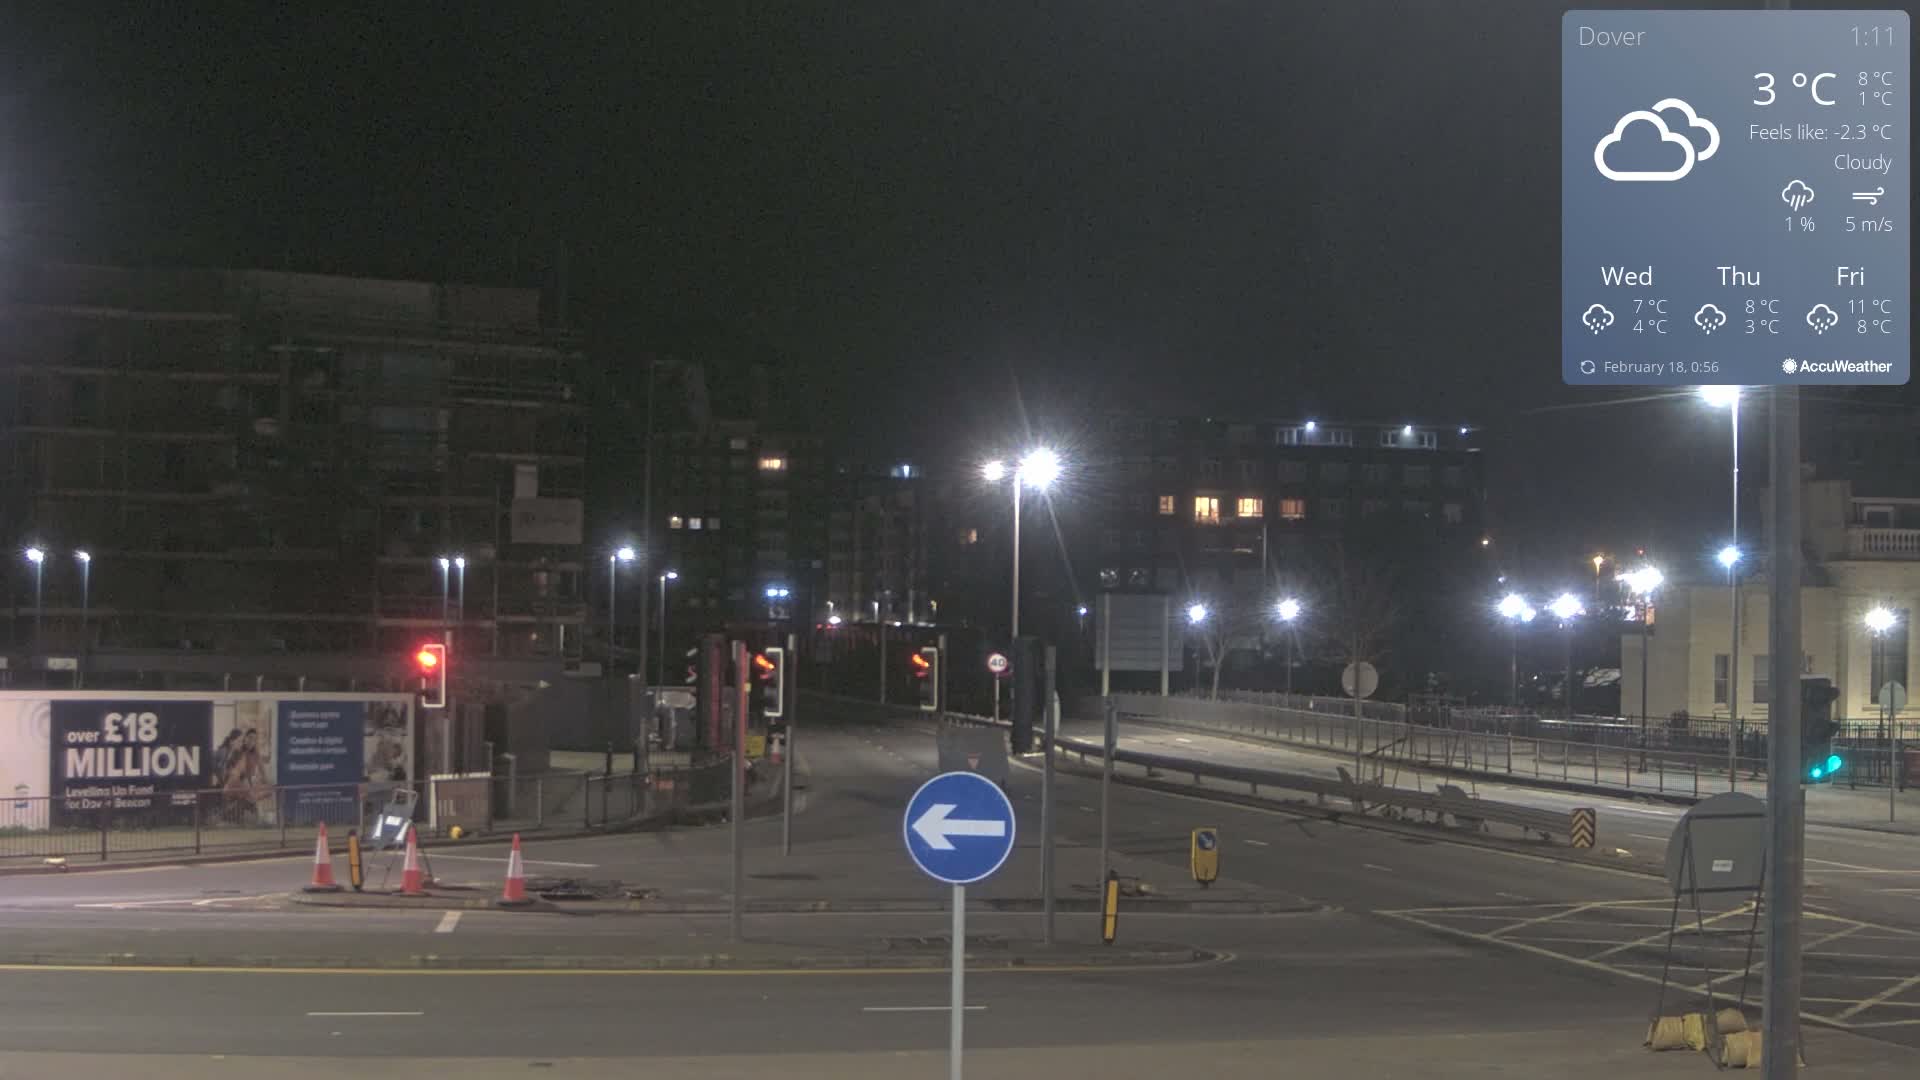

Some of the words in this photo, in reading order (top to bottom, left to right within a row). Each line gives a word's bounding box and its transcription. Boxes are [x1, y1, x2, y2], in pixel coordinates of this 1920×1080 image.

[991, 658, 1005, 667] 40
[67, 731, 99, 743] over
[104, 712, 159, 742] £18
[66, 746, 200, 777] MILLION
